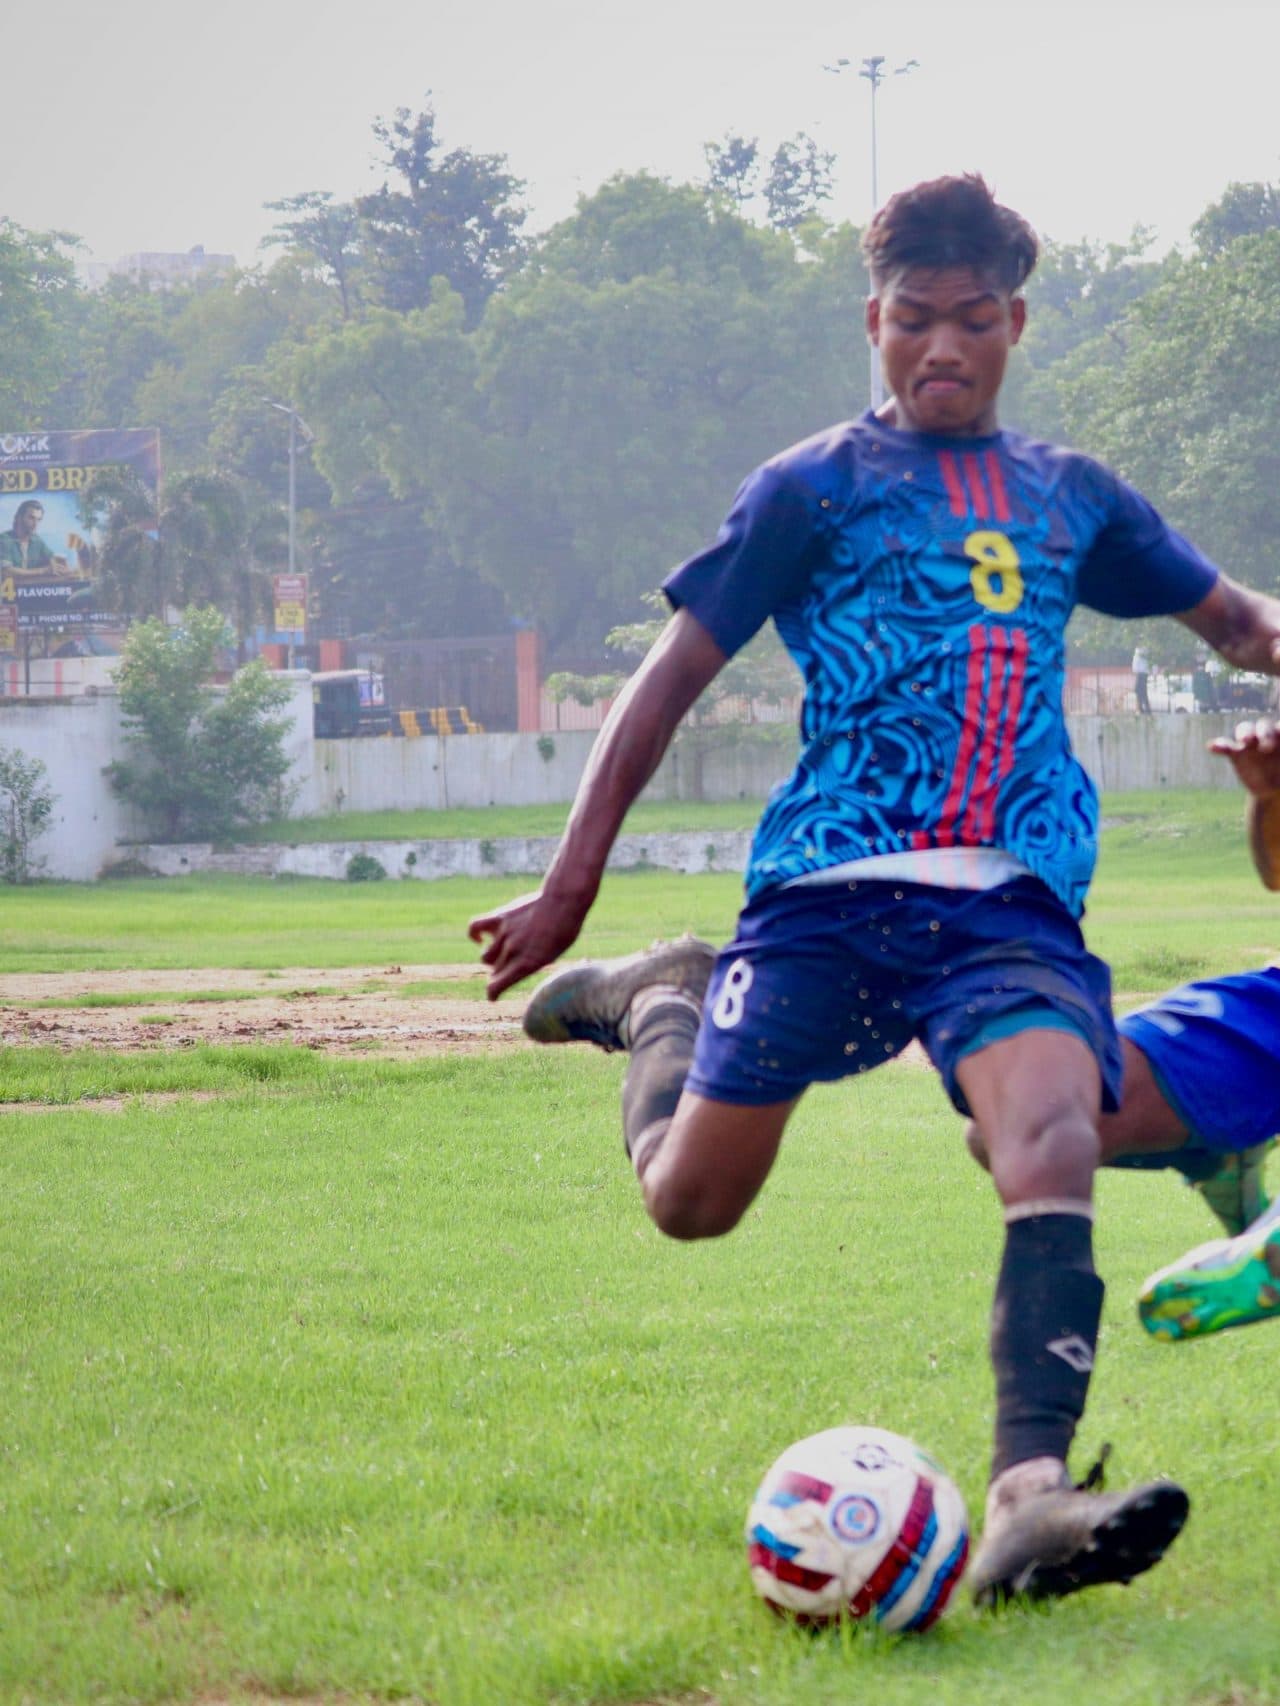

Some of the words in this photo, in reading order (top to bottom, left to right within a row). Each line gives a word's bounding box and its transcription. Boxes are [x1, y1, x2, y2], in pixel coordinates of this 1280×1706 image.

[17, 586, 73, 598] FLAVOURS
[964, 530, 1024, 614] 8
[712, 957, 754, 1029] 8
